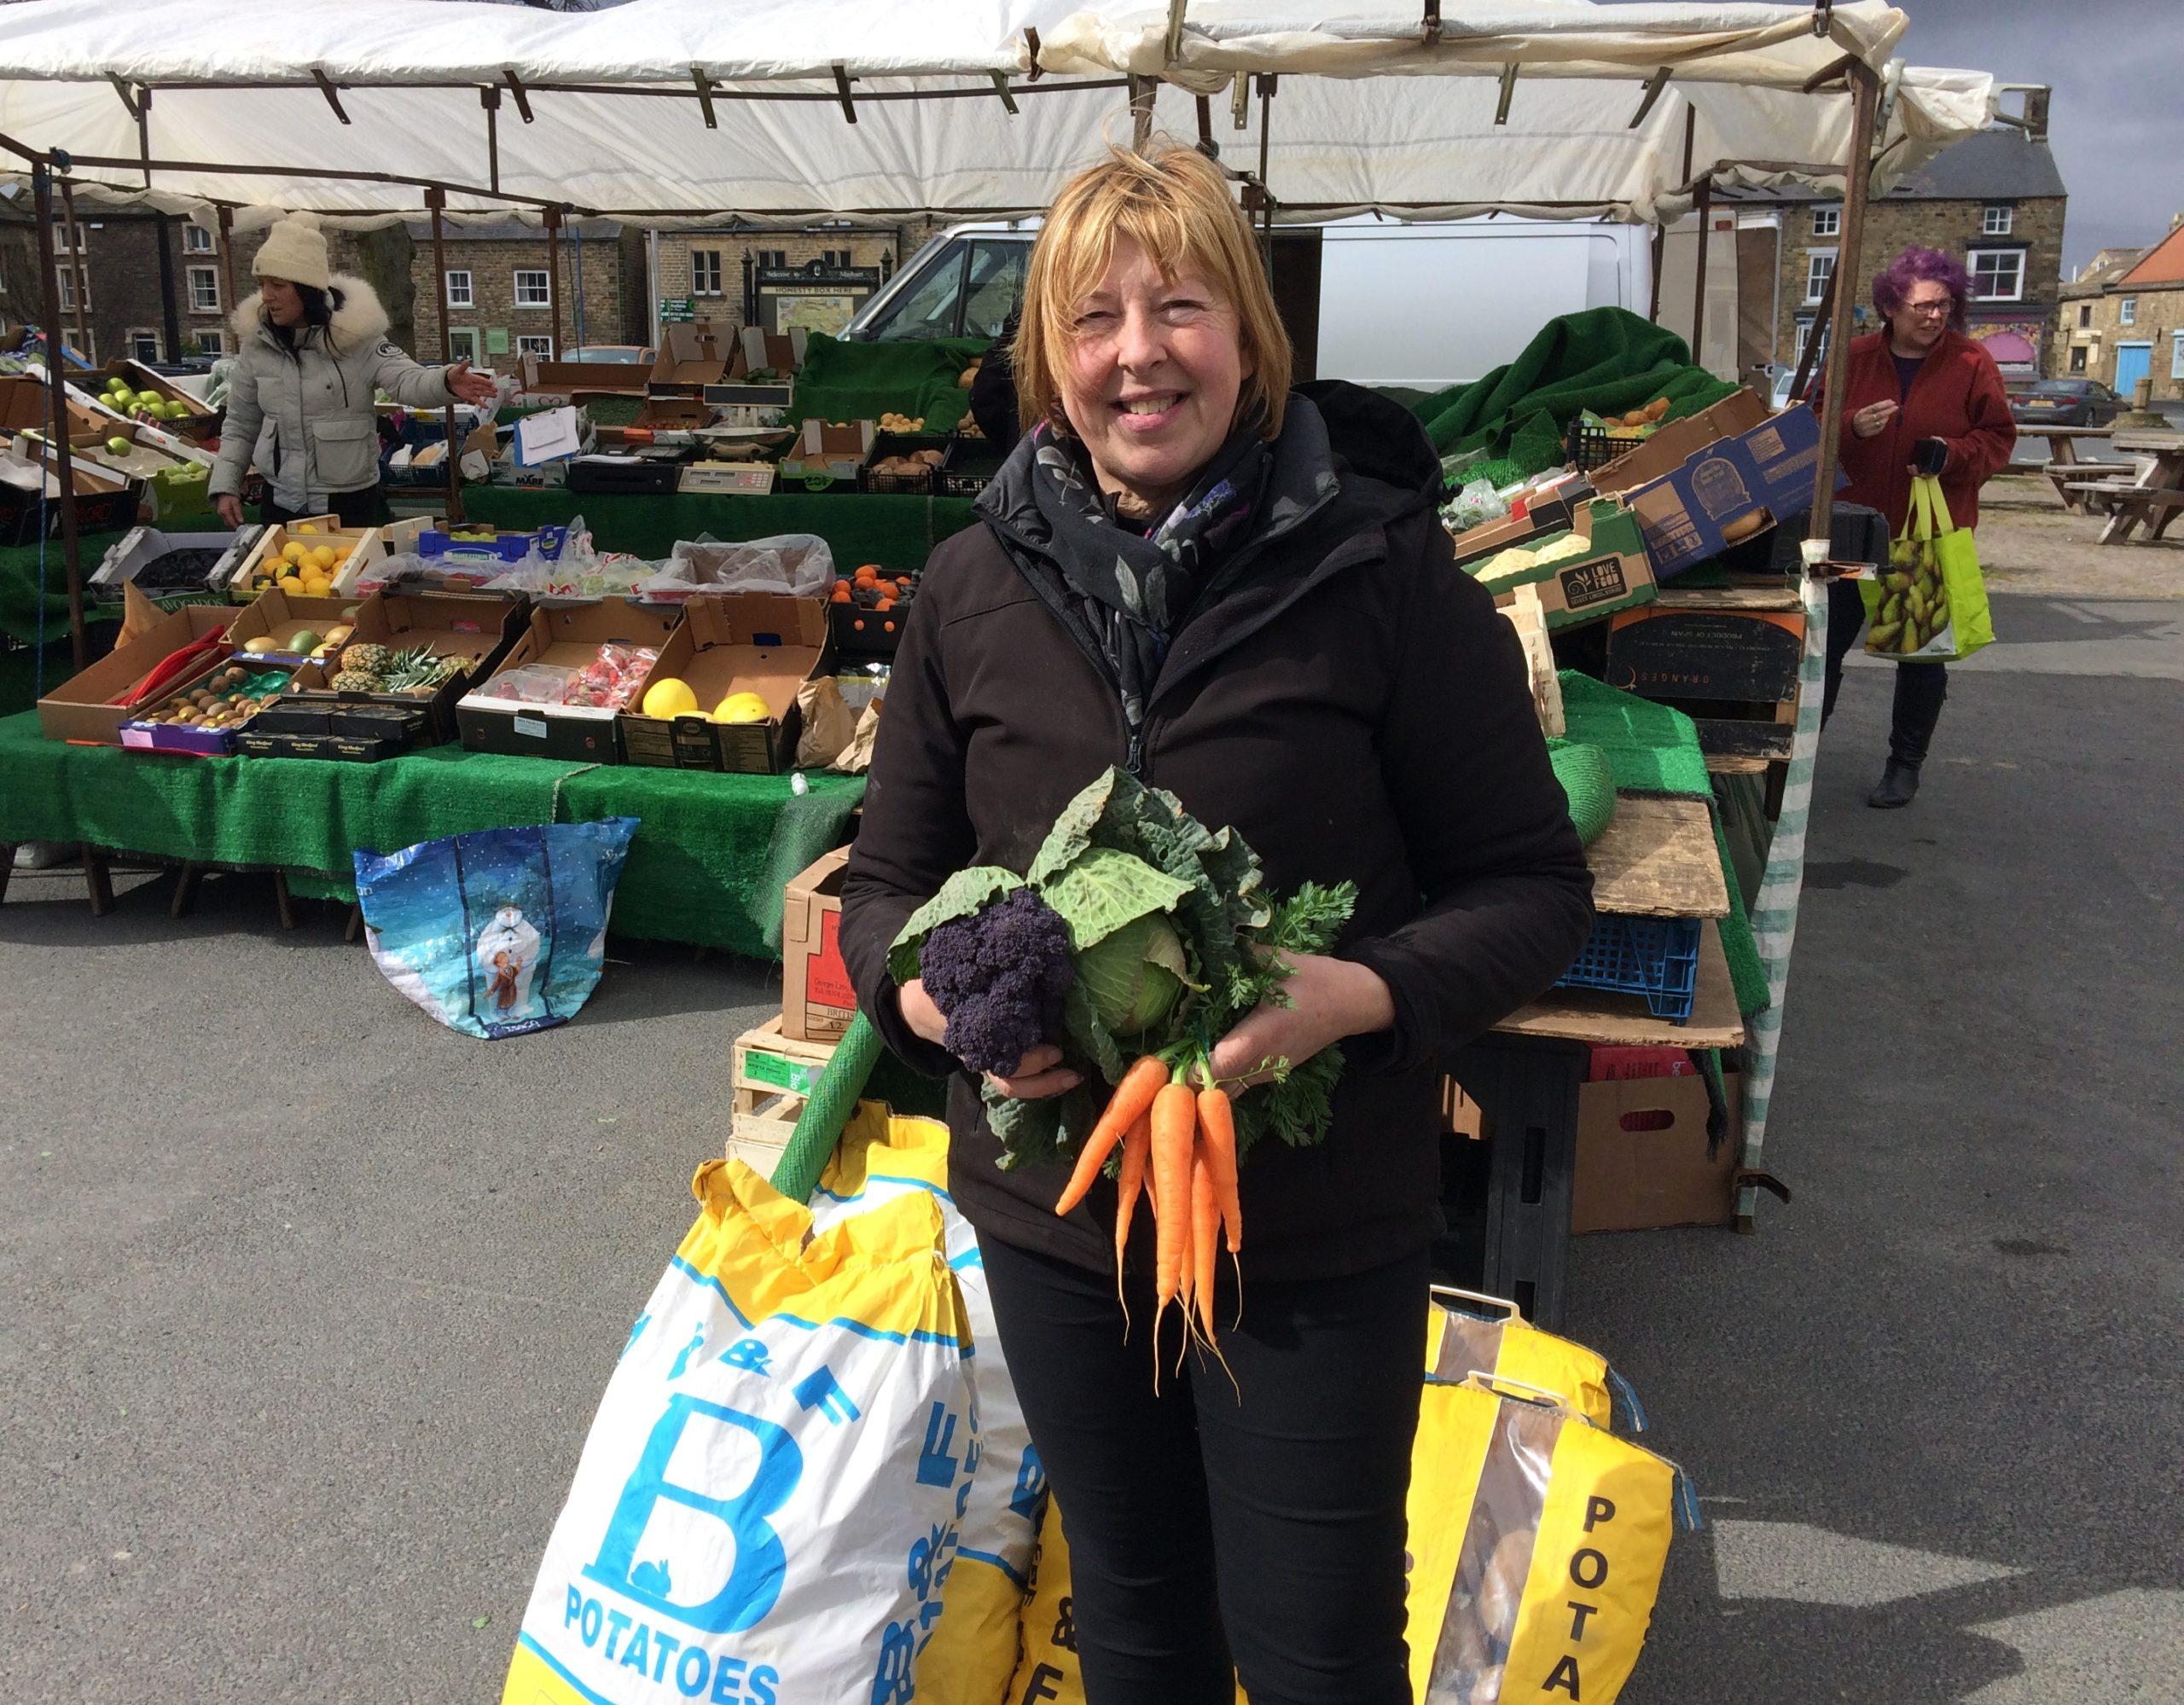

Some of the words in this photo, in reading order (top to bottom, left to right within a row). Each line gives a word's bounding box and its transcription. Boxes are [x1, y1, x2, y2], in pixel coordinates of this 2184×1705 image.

[1590, 561, 1617, 578] LOVE
[1641, 672, 1709, 684] ORANGES
[828, 1007, 854, 1020] BRITIS
[581, 1391, 804, 1635] B
[564, 1582, 779, 1705] POTATOES
